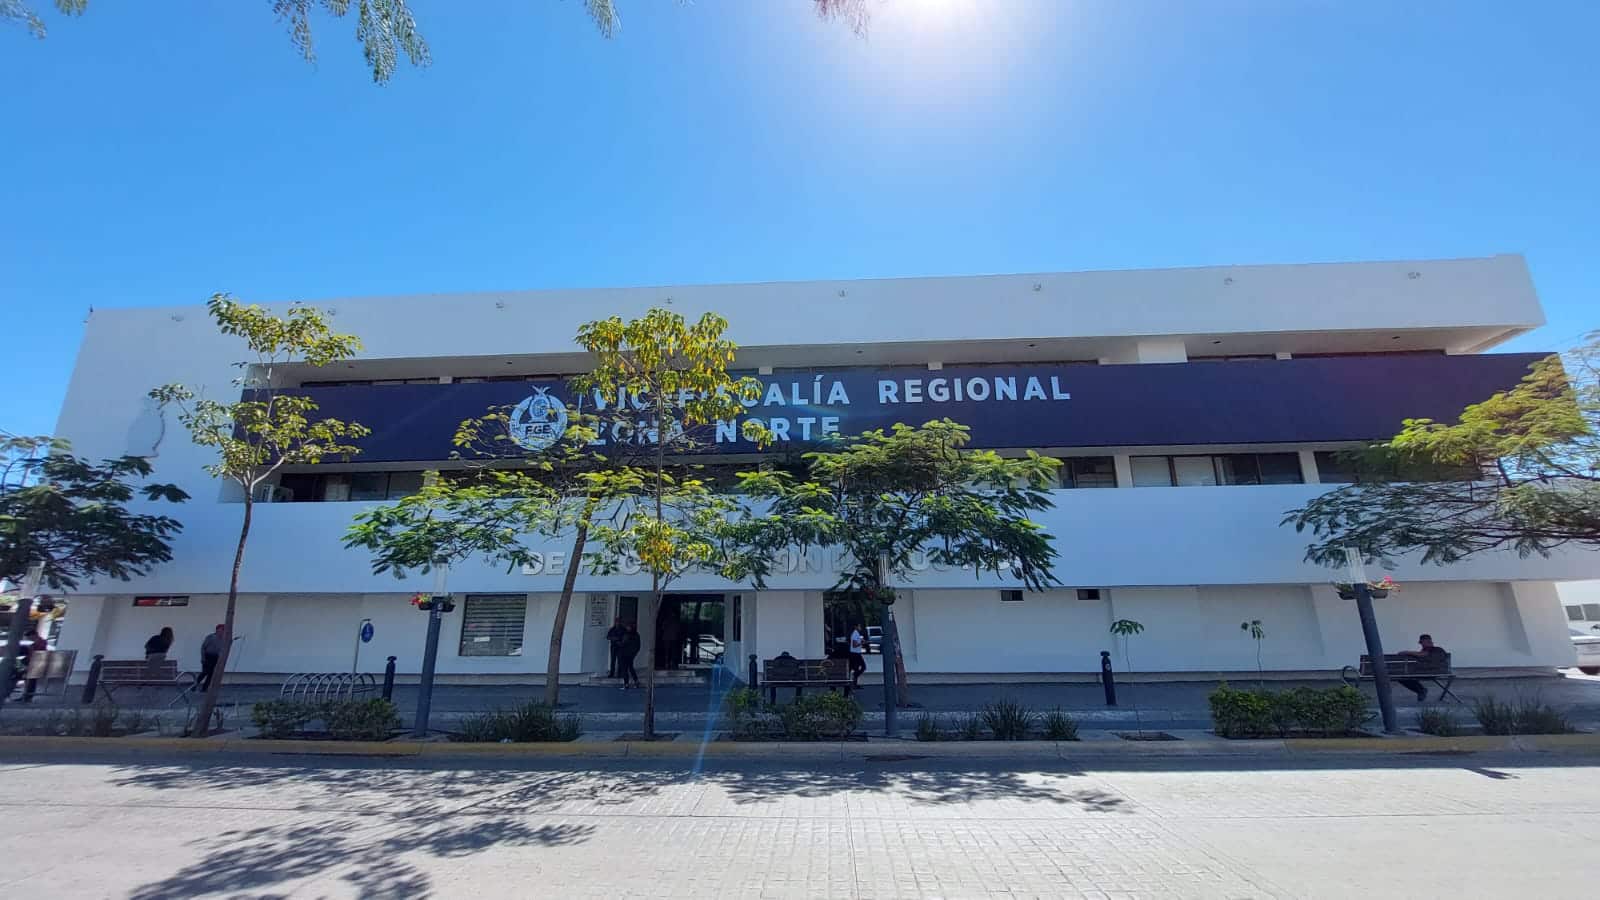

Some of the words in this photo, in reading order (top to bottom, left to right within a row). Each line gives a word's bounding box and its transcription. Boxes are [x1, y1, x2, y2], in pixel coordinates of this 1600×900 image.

[592, 375, 850, 410] VICFCALÍA
[878, 376, 1071, 404] REGIONAL
[525, 424, 552, 436] FGE
[521, 551, 567, 575] DE
